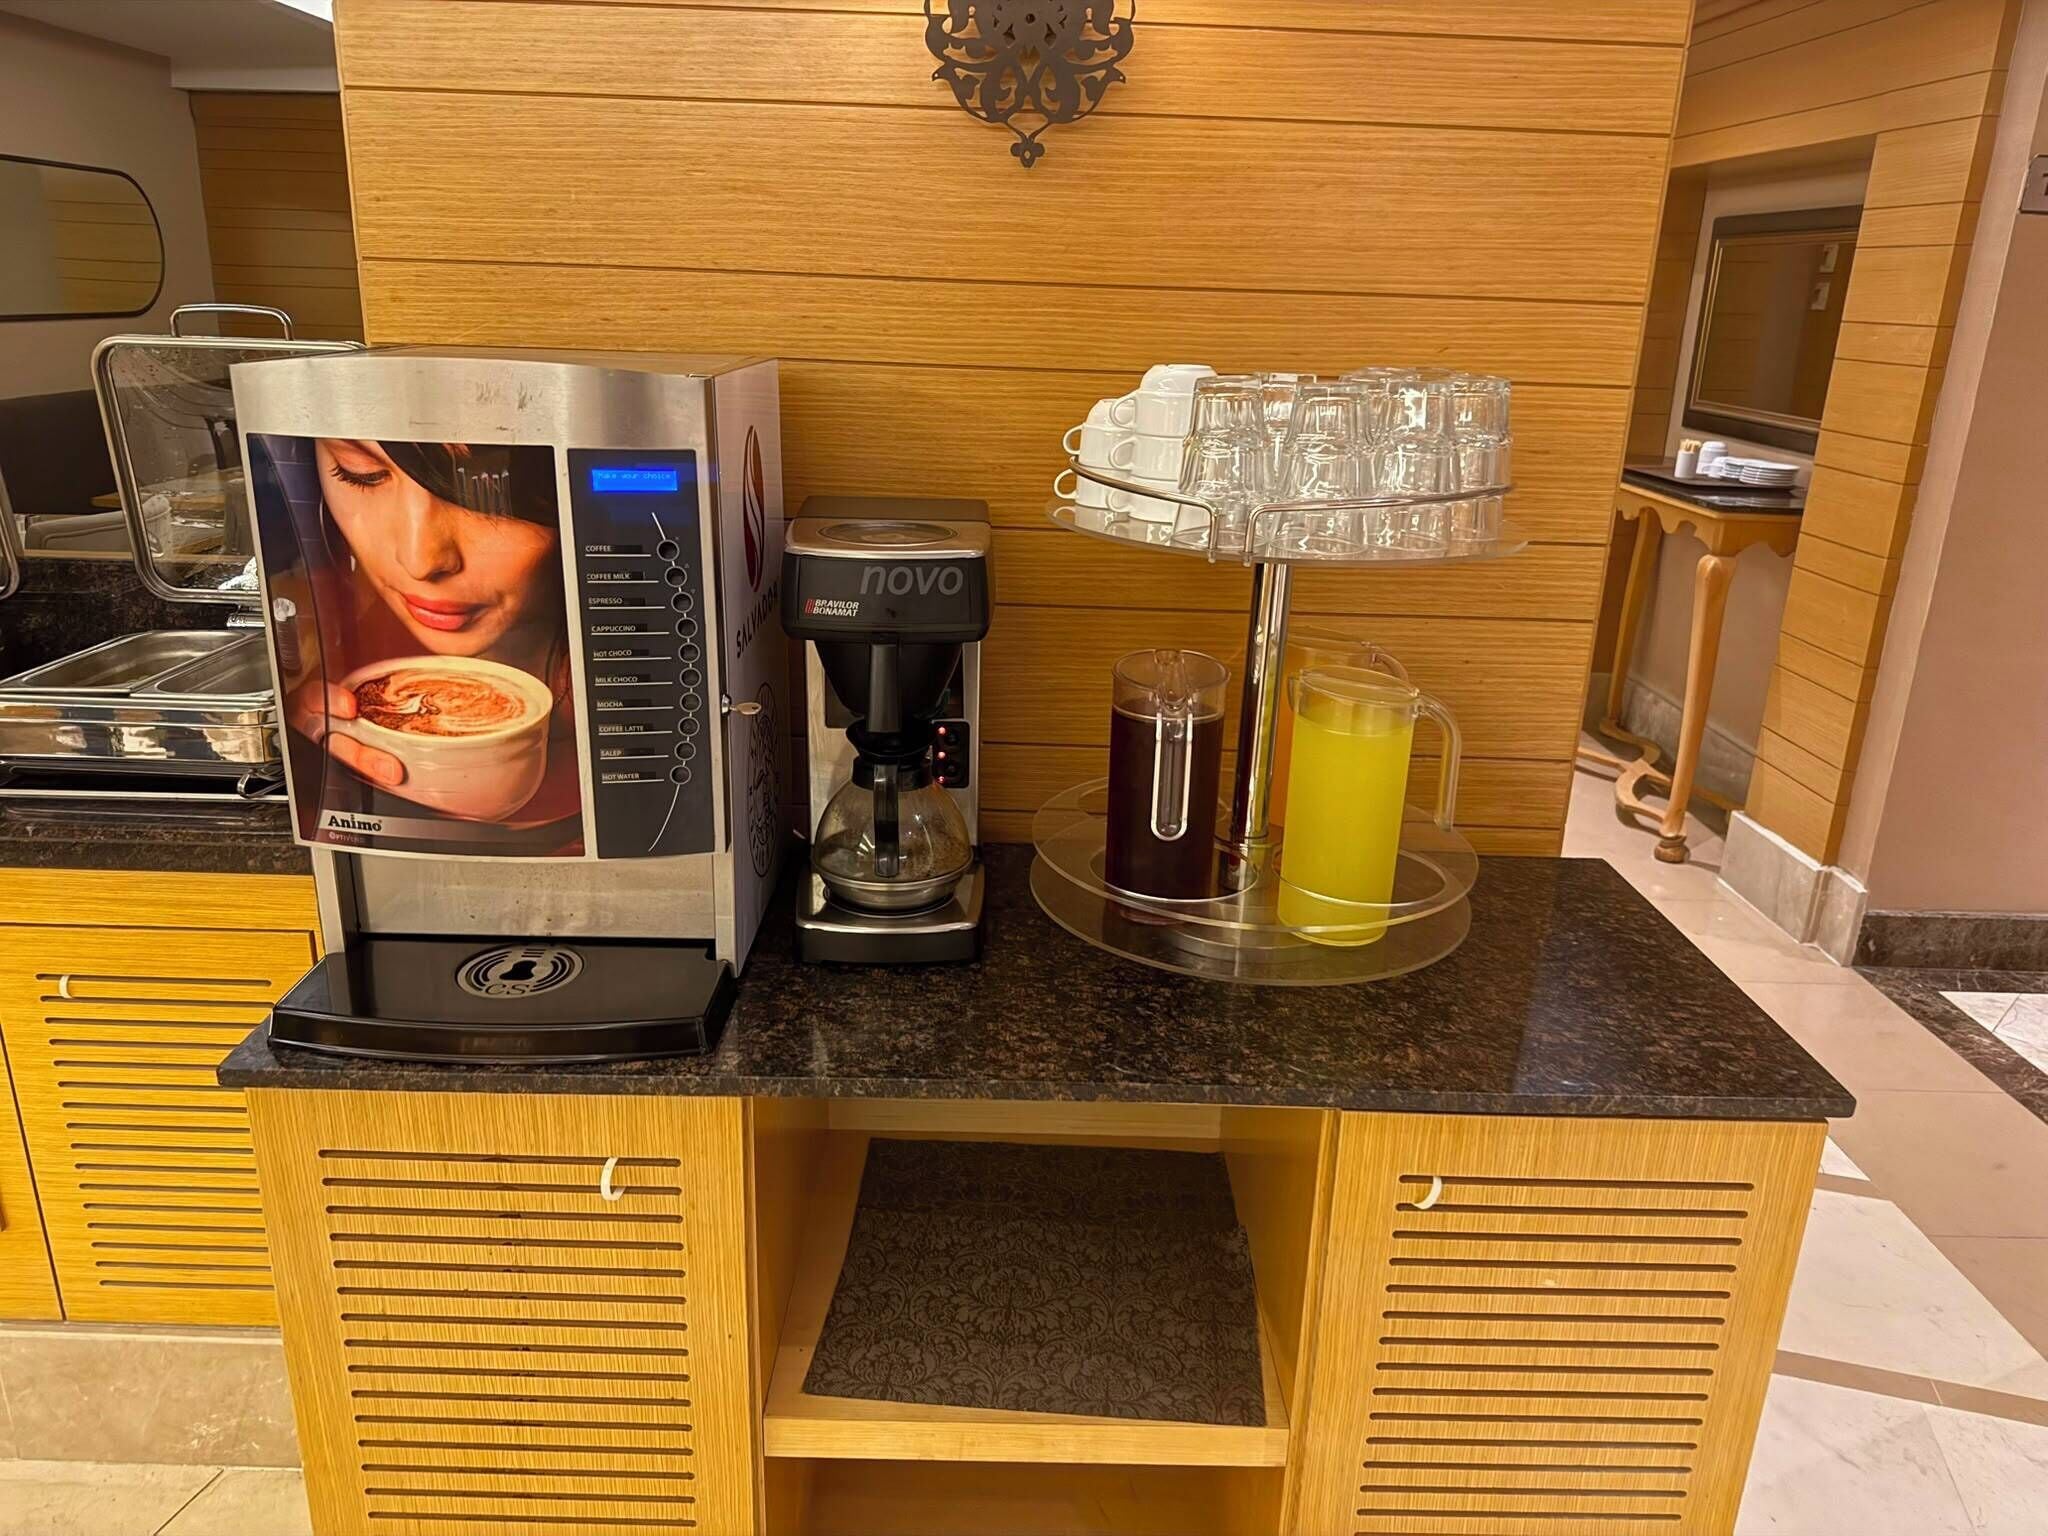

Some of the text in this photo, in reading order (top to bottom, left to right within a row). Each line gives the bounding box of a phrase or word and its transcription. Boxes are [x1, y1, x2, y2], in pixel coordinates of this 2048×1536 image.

[585, 545, 612, 553] COFFEE
[613, 572, 631, 580] MILK
[860, 565, 964, 596] novo
[588, 597, 623, 605] ESPRESSO
[814, 599, 860, 610] BRAVILOR
[812, 606, 859, 617] BONAMAT
[591, 625, 636, 633] CAPPUCCINO
[593, 649, 633, 658] HOT CHOCO
[595, 675, 639, 684] MILK CHOCO
[596, 701, 624, 709] MOCHA
[598, 724, 645, 733] COFFEE LATTE
[600, 749, 622, 757] SALEP
[601, 772, 640, 781] HOT WATER
[328, 814, 382, 832] Animo
